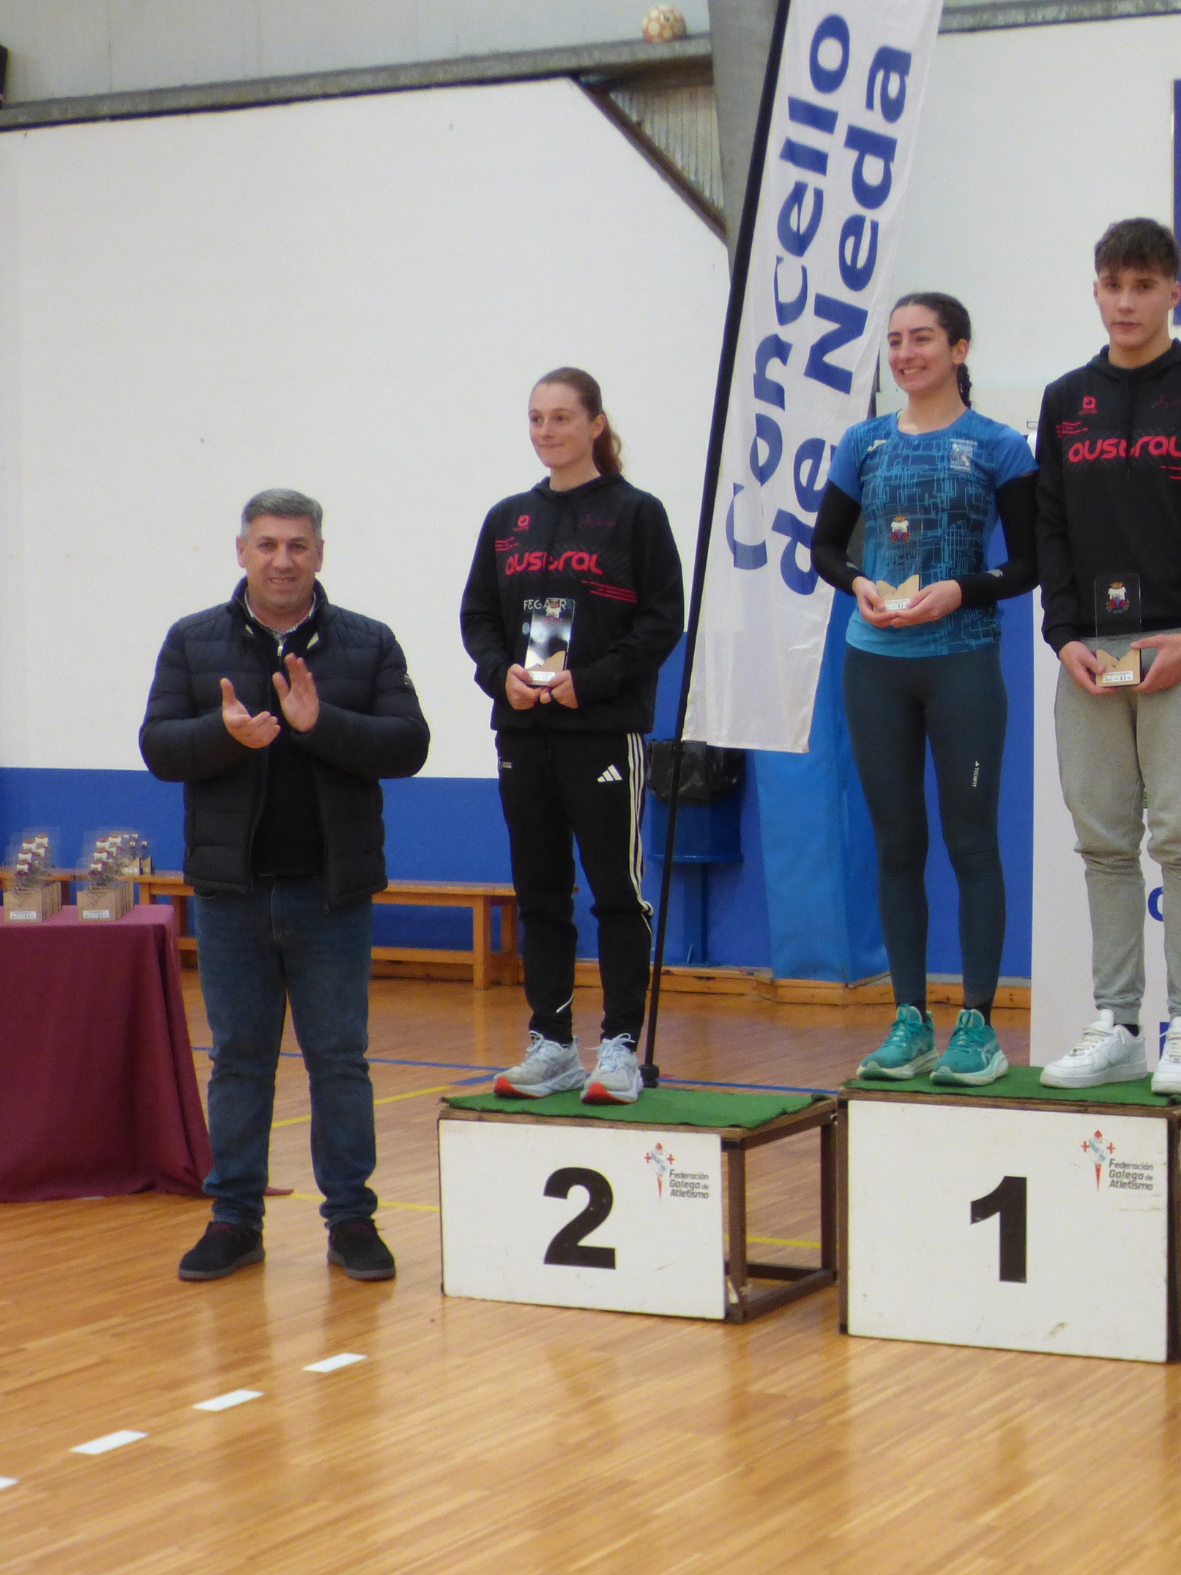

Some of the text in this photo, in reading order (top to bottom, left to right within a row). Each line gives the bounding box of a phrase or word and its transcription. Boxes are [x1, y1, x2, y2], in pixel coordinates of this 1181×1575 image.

[725, 14, 851, 571] Concello
[770, 44, 912, 596] de Neda
[1108, 1158, 1154, 1170] Federación
[669, 1168, 709, 1180] Federación
[1108, 1169, 1144, 1183] Galega
[669, 1179, 701, 1191] Galega
[1109, 1179, 1154, 1191] Atletismo
[670, 1189, 709, 1199] Atletismo
[542, 1166, 617, 1270] 2
[969, 1175, 1028, 1284] 1
